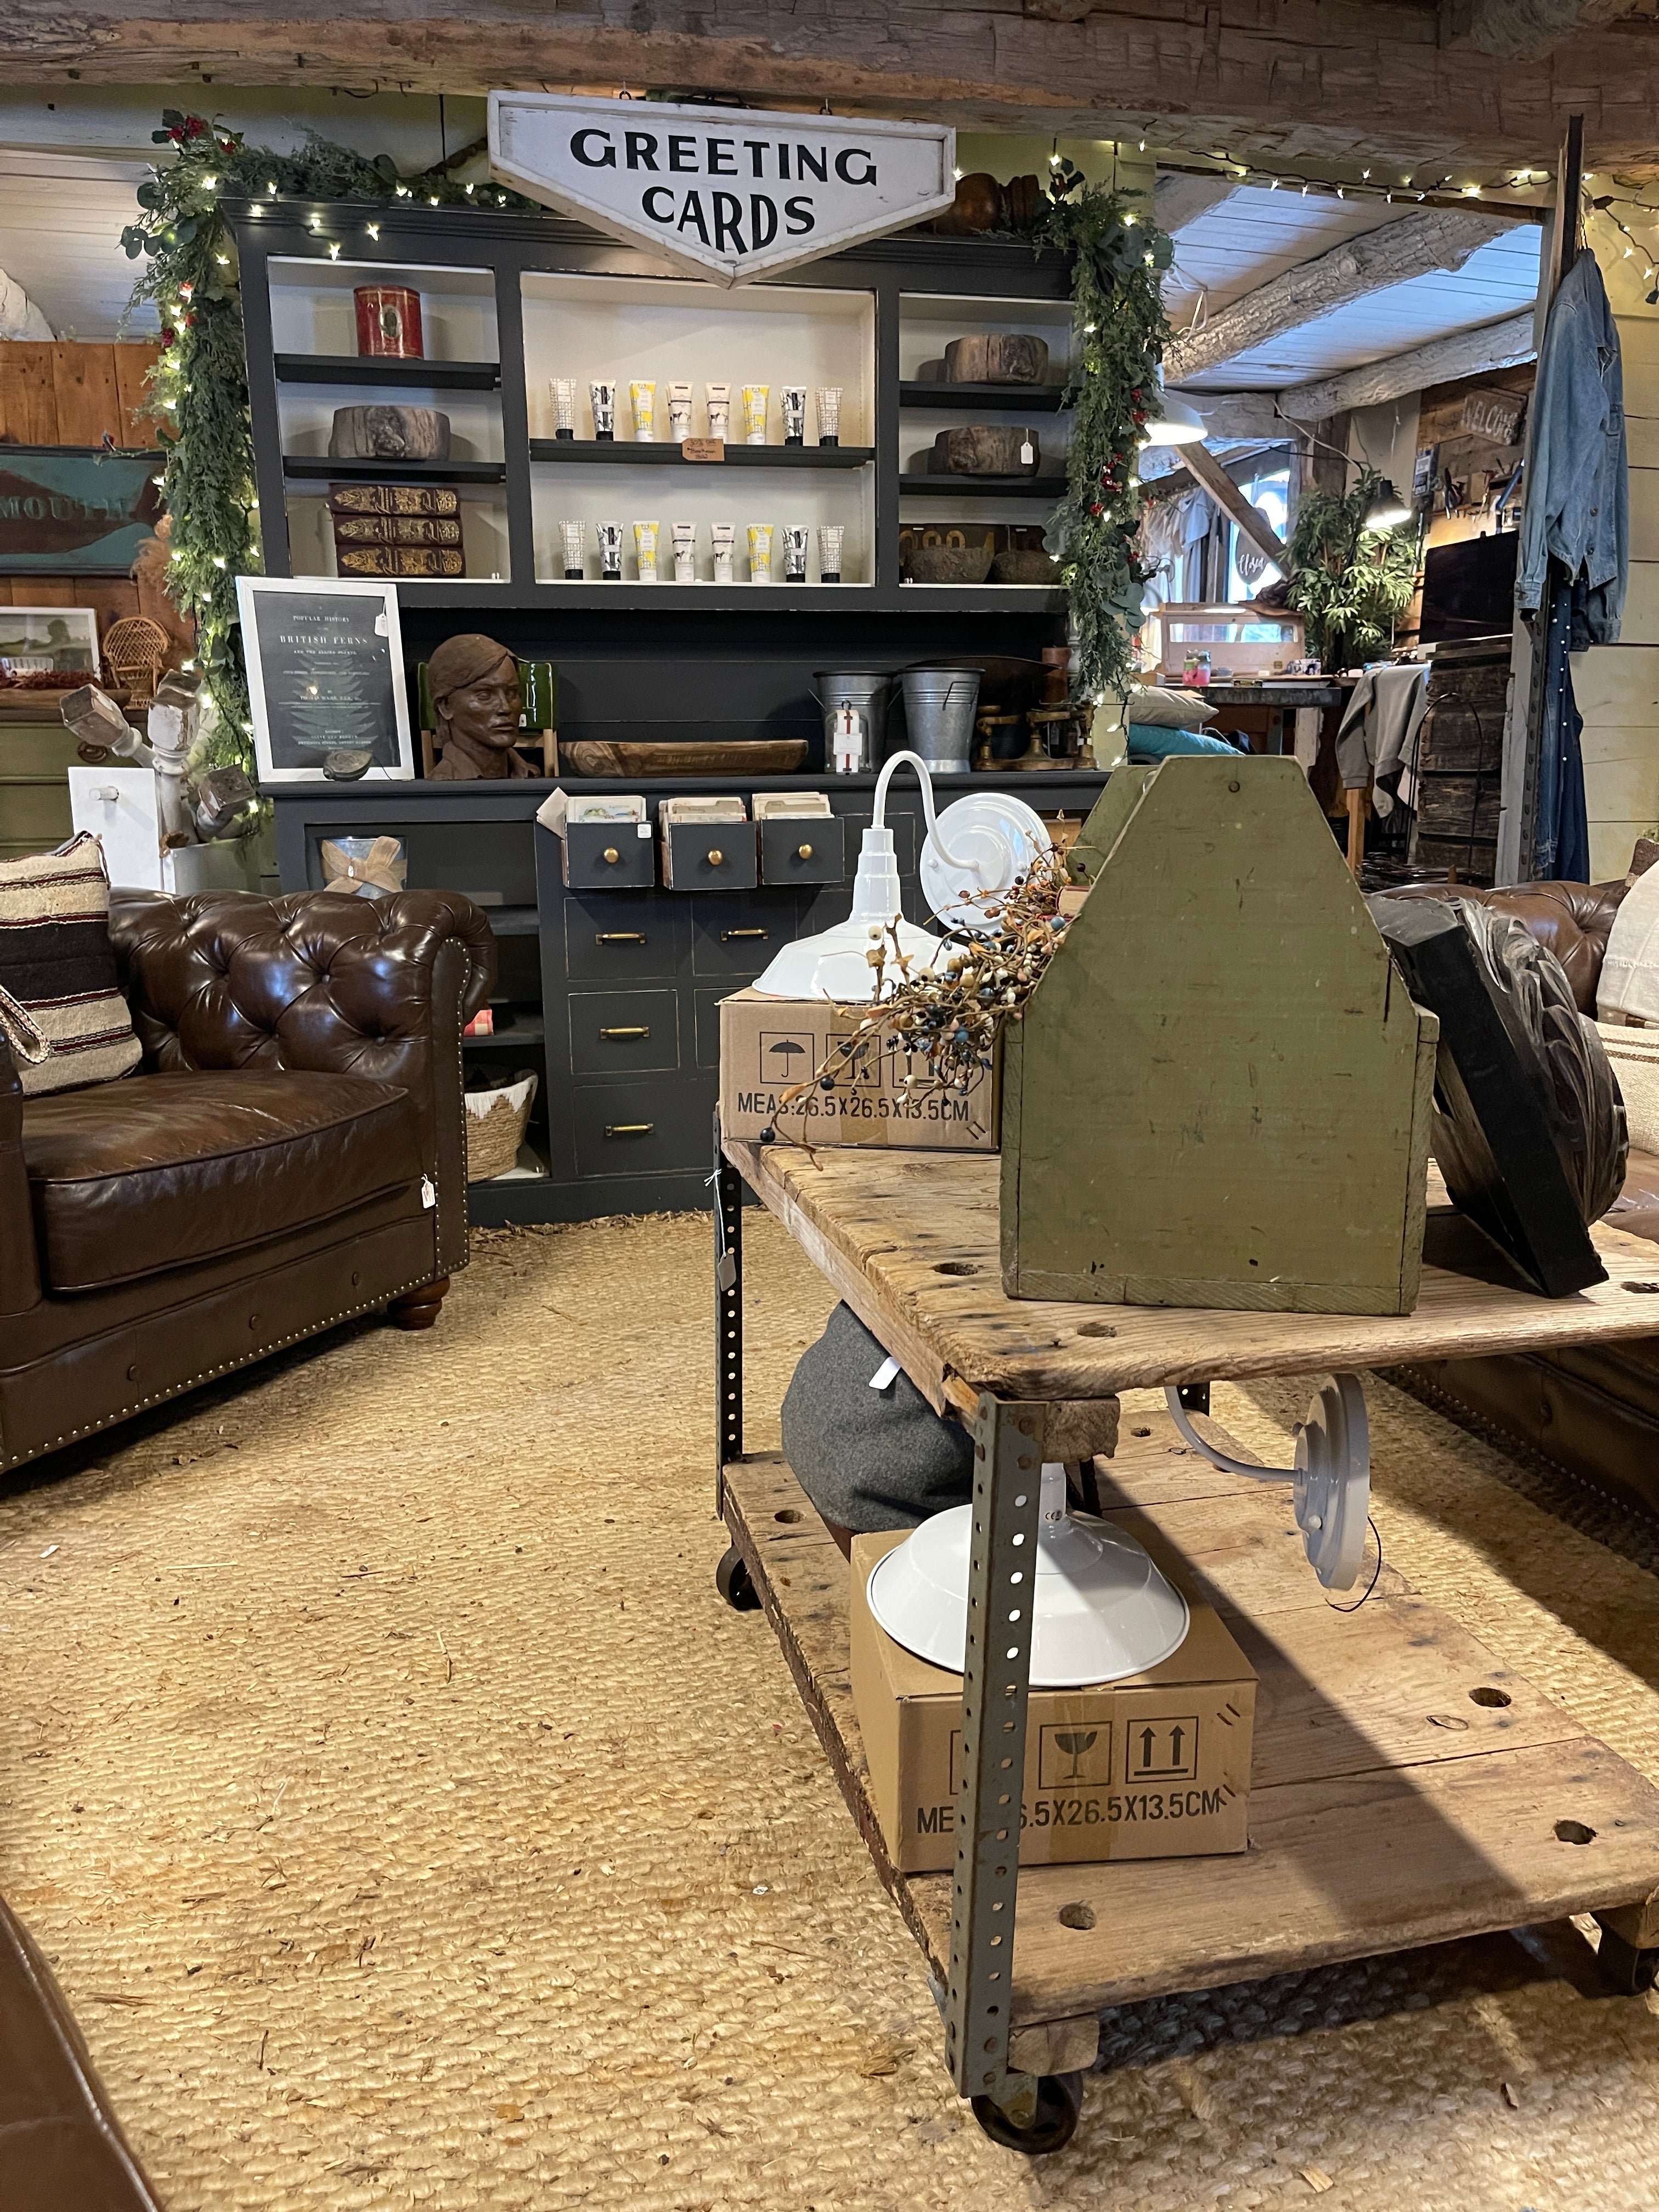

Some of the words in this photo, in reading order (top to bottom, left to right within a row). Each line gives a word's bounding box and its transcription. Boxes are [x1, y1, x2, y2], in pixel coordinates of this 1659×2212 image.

[570, 128, 877, 186] GREETING
[642, 186, 815, 255] CARDS
[280, 635, 326, 644] BRITISH
